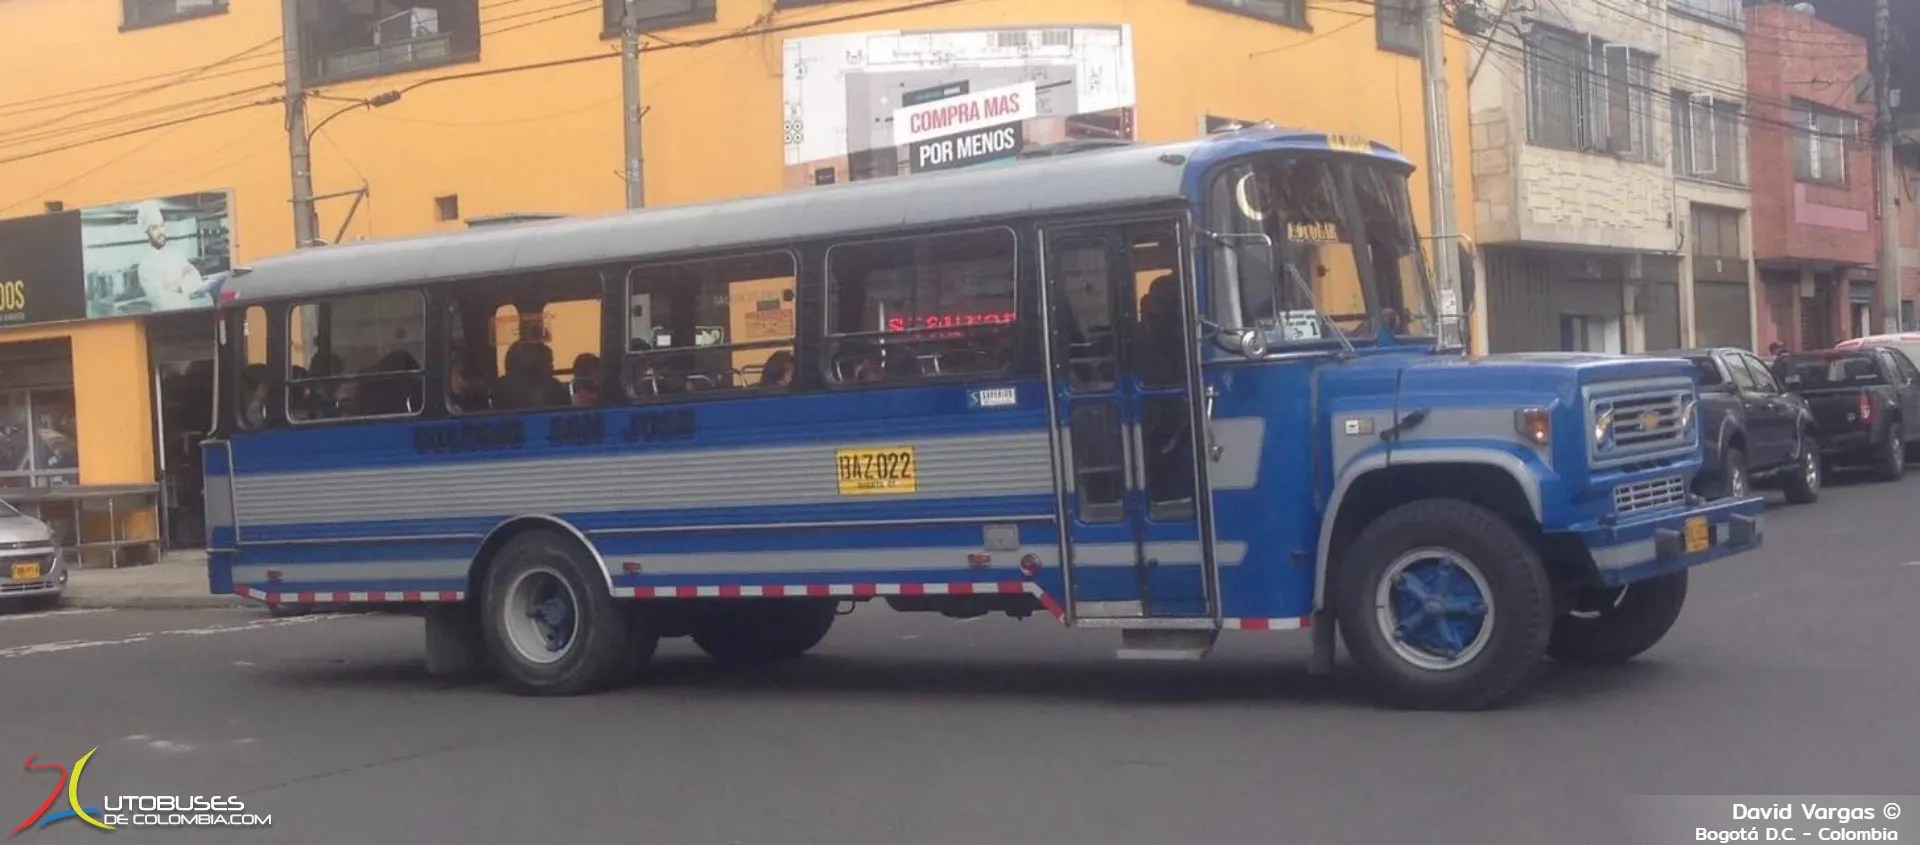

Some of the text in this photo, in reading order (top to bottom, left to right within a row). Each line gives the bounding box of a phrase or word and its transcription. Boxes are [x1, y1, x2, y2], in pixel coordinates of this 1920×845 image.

[910, 102, 980, 134] COMPRA
[984, 93, 1020, 119] MAS
[919, 127, 1015, 167] POR MENOS
